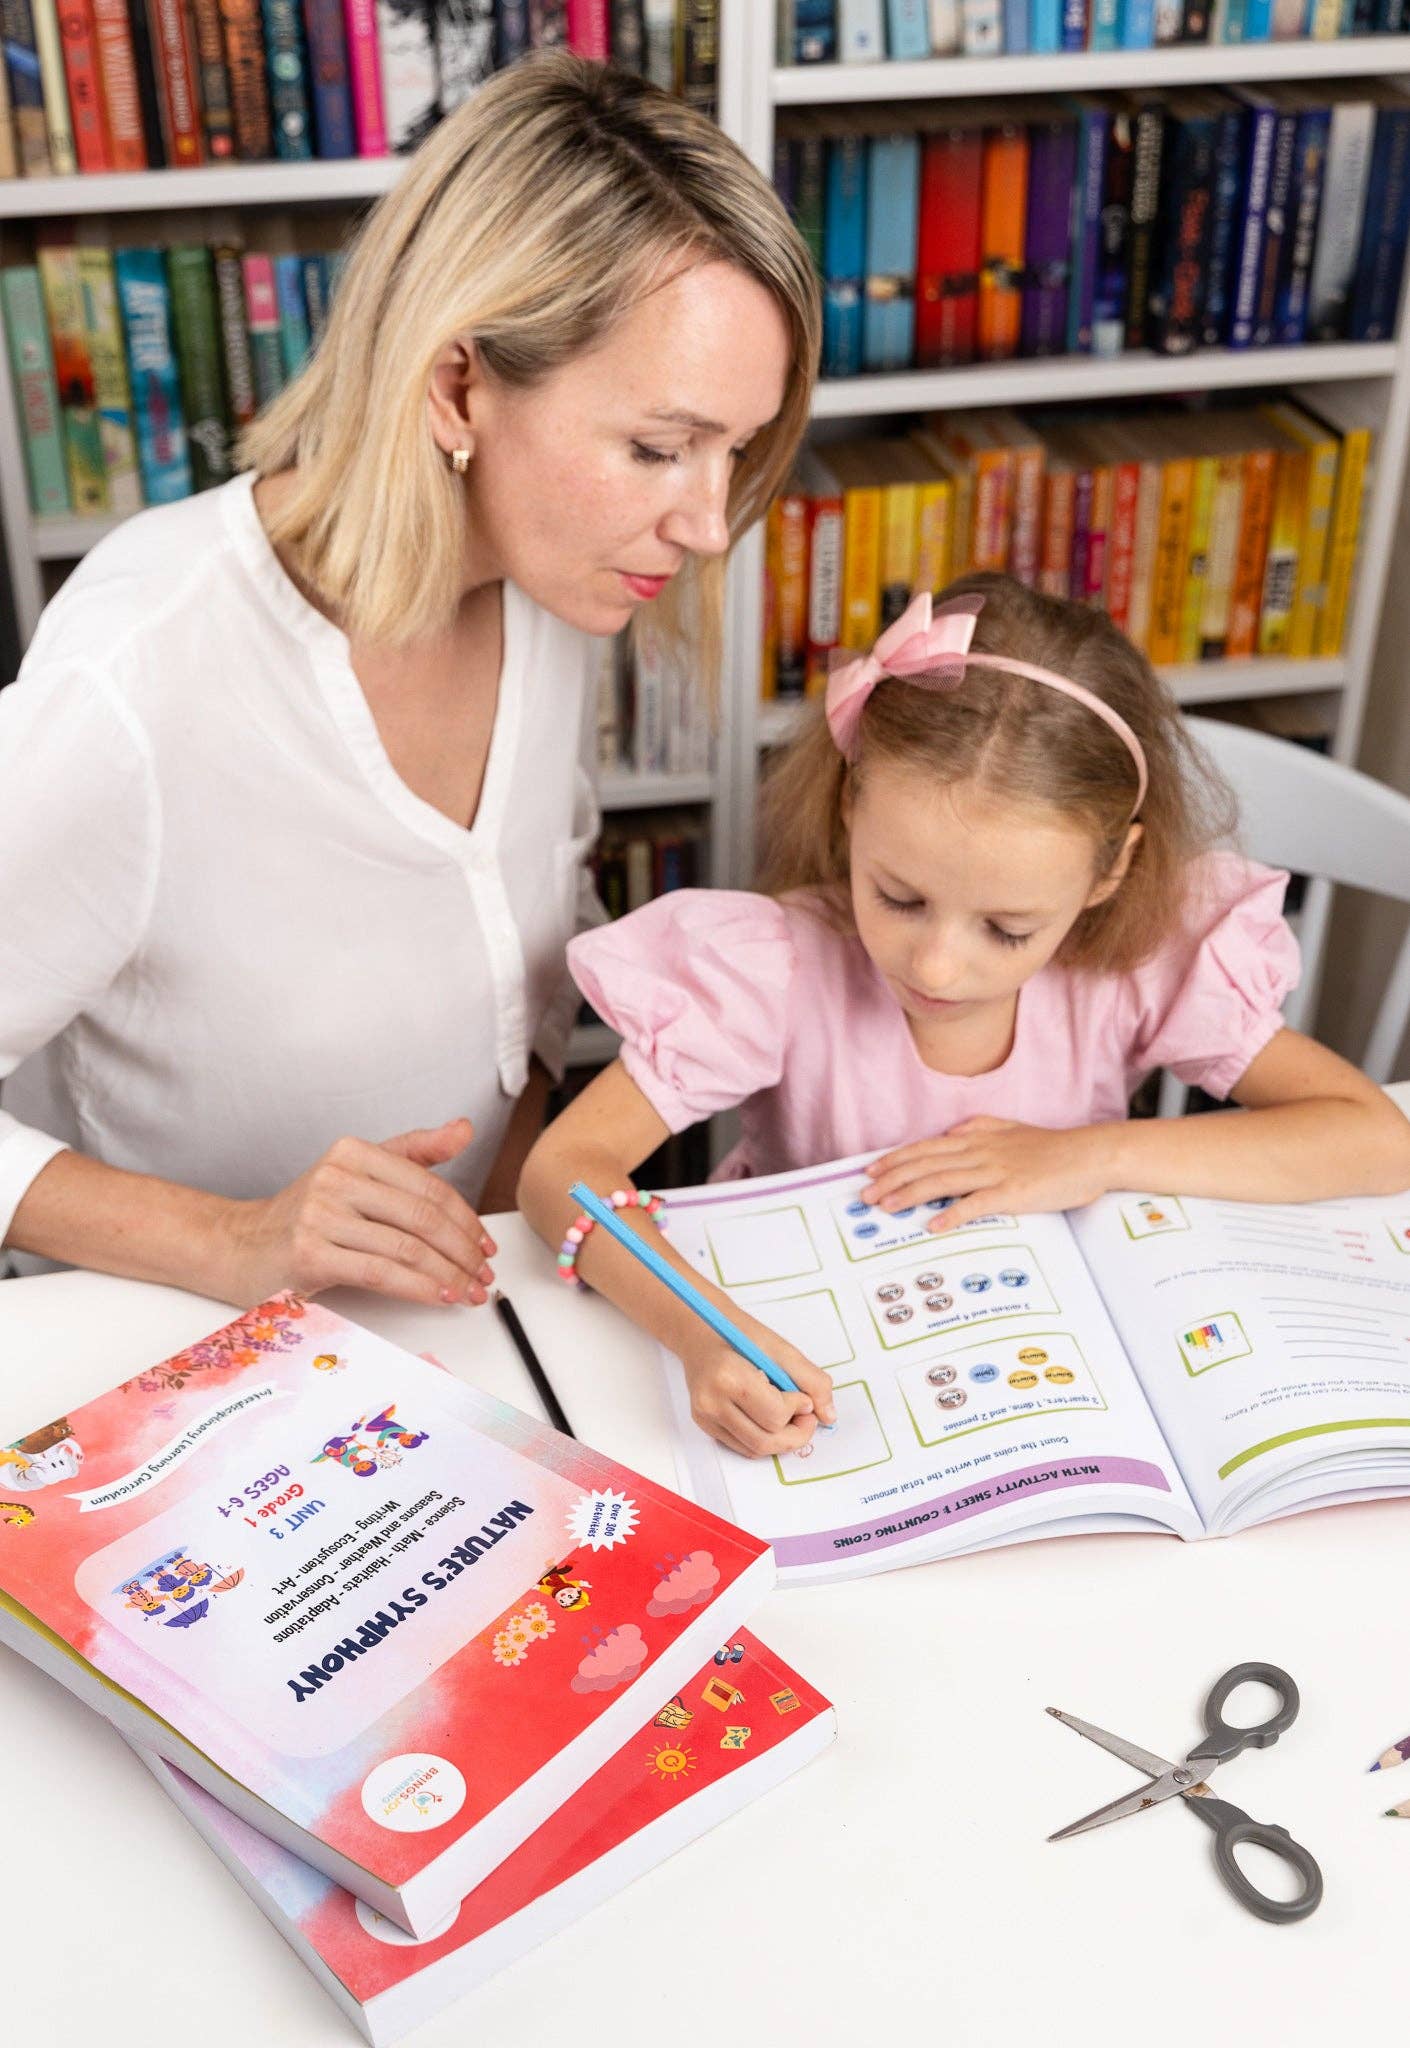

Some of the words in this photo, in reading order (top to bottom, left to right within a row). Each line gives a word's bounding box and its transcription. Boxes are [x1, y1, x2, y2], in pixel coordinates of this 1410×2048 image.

[187, 1388, 272, 1439] Interdisciplinary
[993, 1446, 1018, 1457] coins
[1019, 1440, 1036, 1452] the
[1040, 1436, 1069, 1447] Count
[147, 1439, 191, 1472] Learning
[945, 1461, 972, 1474] write
[973, 1454, 991, 1466] and
[244, 1464, 290, 1499] AGES
[926, 1470, 943, 1483] the
[996, 1470, 1058, 1496] ACTIVITY
[1061, 1465, 1100, 1477] MATH
[90, 1472, 152, 1505] Curriculum
[862, 1487, 898, 1504] amount:
[900, 1478, 924, 1493] total
[217, 1497, 244, 1518] 6-7
[257, 1483, 304, 1518] Grade
[399, 1490, 443, 1522] Seasons
[424, 1496, 466, 1526] Science
[610, 1503, 621, 1520] Over
[956, 1490, 992, 1511] SHEET
[242, 1515, 259, 1529] 1
[284, 1500, 326, 1531] UNIT
[355, 1500, 401, 1530] Writing
[587, 1502, 605, 1537] Activities
[874, 1510, 939, 1538] COUNTING
[267, 1525, 286, 1542] 3
[379, 1520, 402, 1539] and
[391, 1529, 424, 1552] Math
[604, 1522, 616, 1536] 300
[833, 1533, 871, 1548] COINS
[298, 1533, 357, 1574] Ecosystem
[339, 1536, 387, 1570] Weather
[421, 1500, 534, 1590] NATURE'S
[271, 1576, 297, 1595] Art
[342, 1556, 391, 1591] Habitats
[263, 1574, 335, 1624] Conservation
[273, 1594, 340, 1643] Adaptations
[287, 1587, 428, 1702] SYMPHONY
